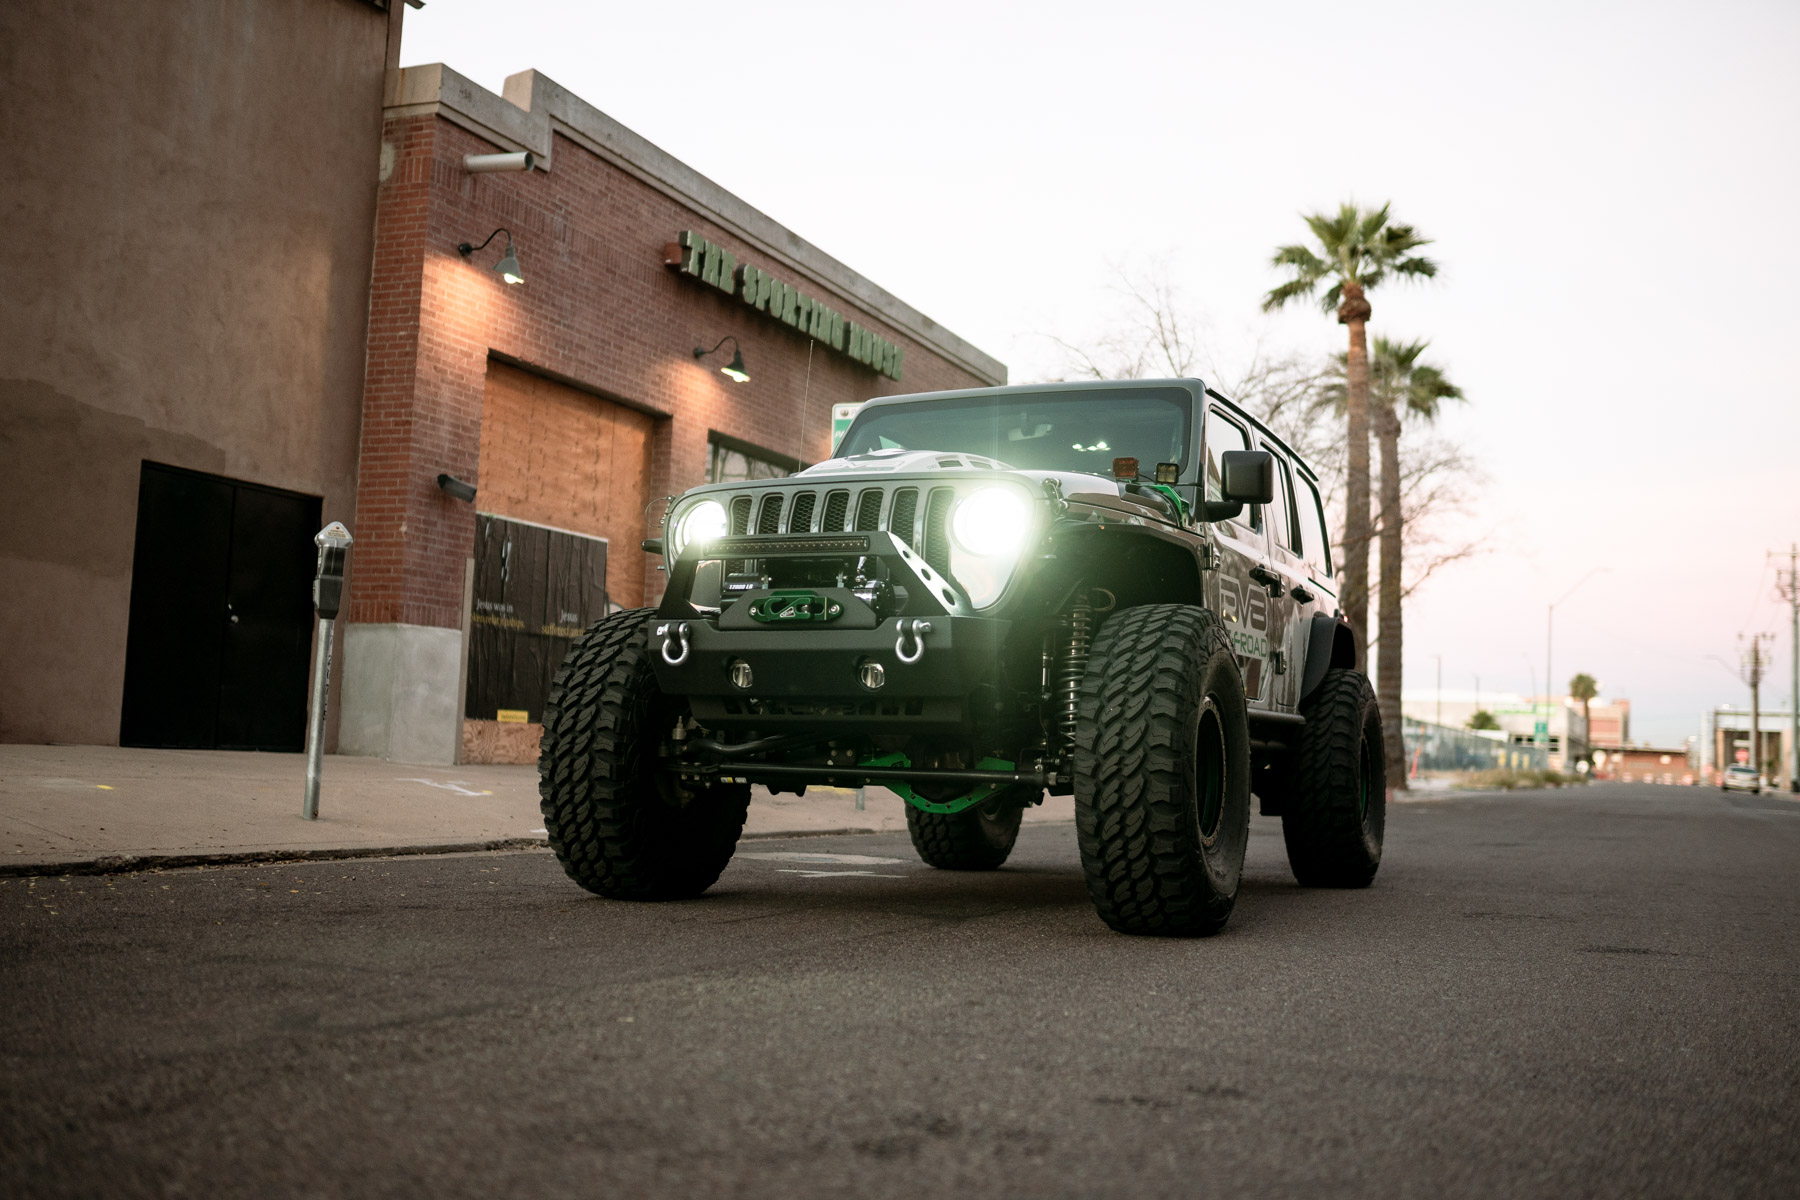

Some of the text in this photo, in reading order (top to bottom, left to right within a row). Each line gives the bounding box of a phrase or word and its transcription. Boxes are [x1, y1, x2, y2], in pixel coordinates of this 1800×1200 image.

[681, 229, 904, 381] THE SPORTING HOUSE
[476, 598, 514, 613] Jesus was in
[560, 610, 578, 623] Jesus
[541, 623, 569, 637] suffered
